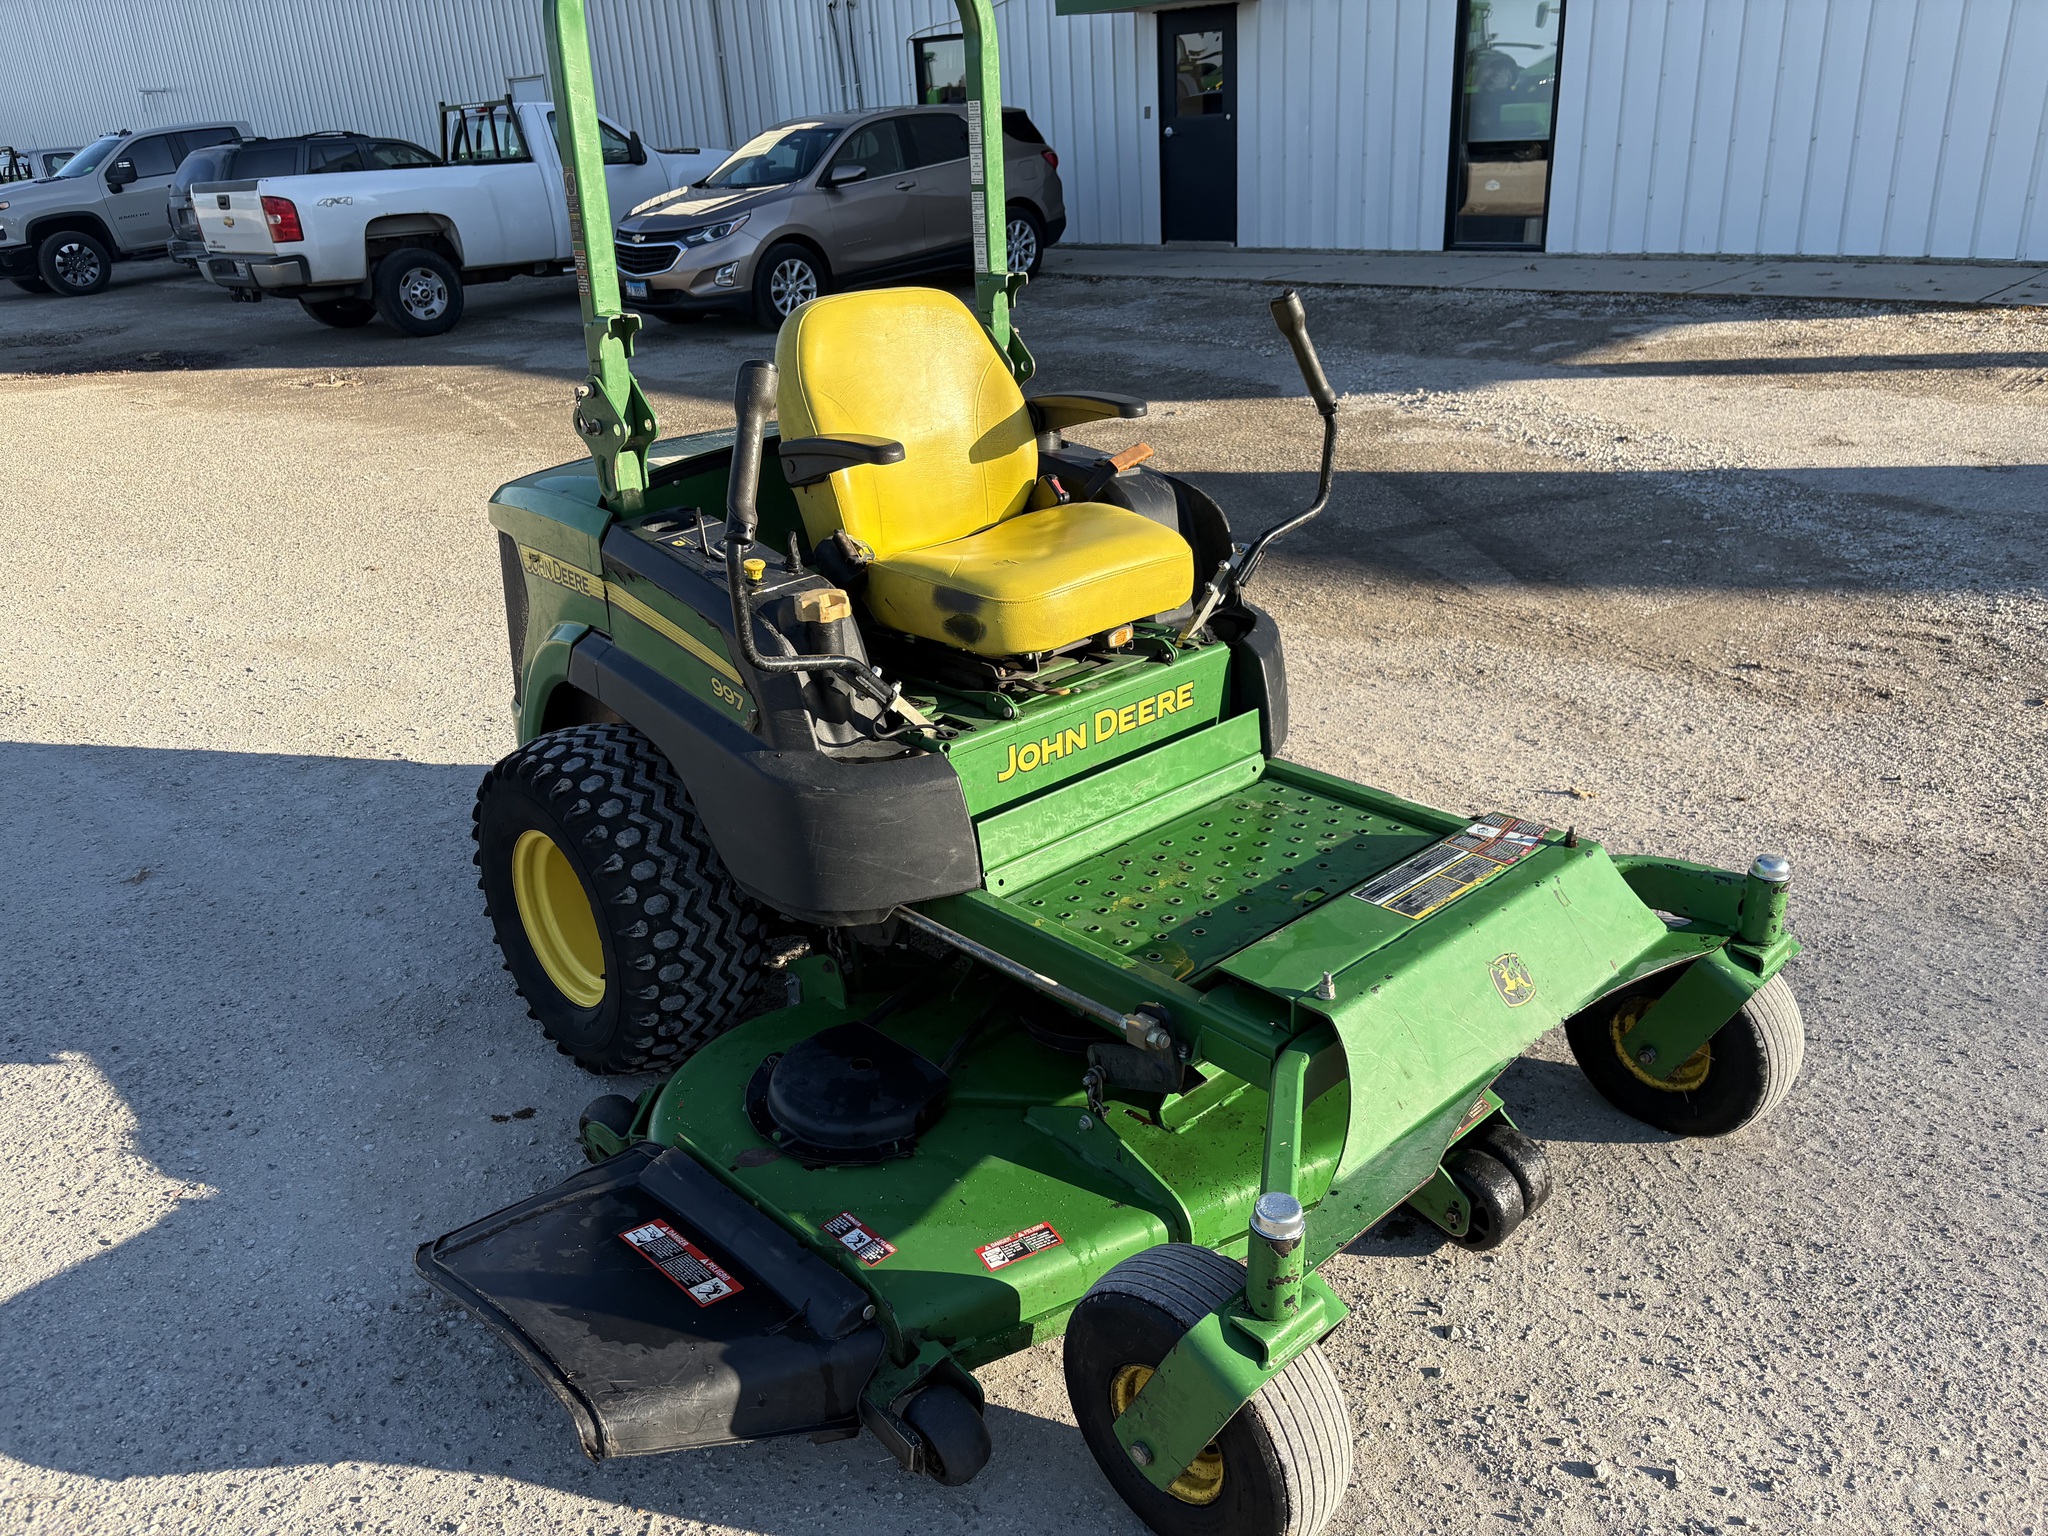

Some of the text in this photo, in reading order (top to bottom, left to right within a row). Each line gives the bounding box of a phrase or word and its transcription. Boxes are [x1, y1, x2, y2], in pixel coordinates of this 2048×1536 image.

[527, 553, 591, 597] JOHN DEERE
[710, 676, 744, 712] 997
[997, 681, 1195, 783] JOHN DEERE
[666, 1229, 689, 1247] DANGER
[706, 1261, 731, 1282] PELIGRO
[990, 1235, 1012, 1248] DANGER
[1023, 1223, 1045, 1235] PELIGRO
